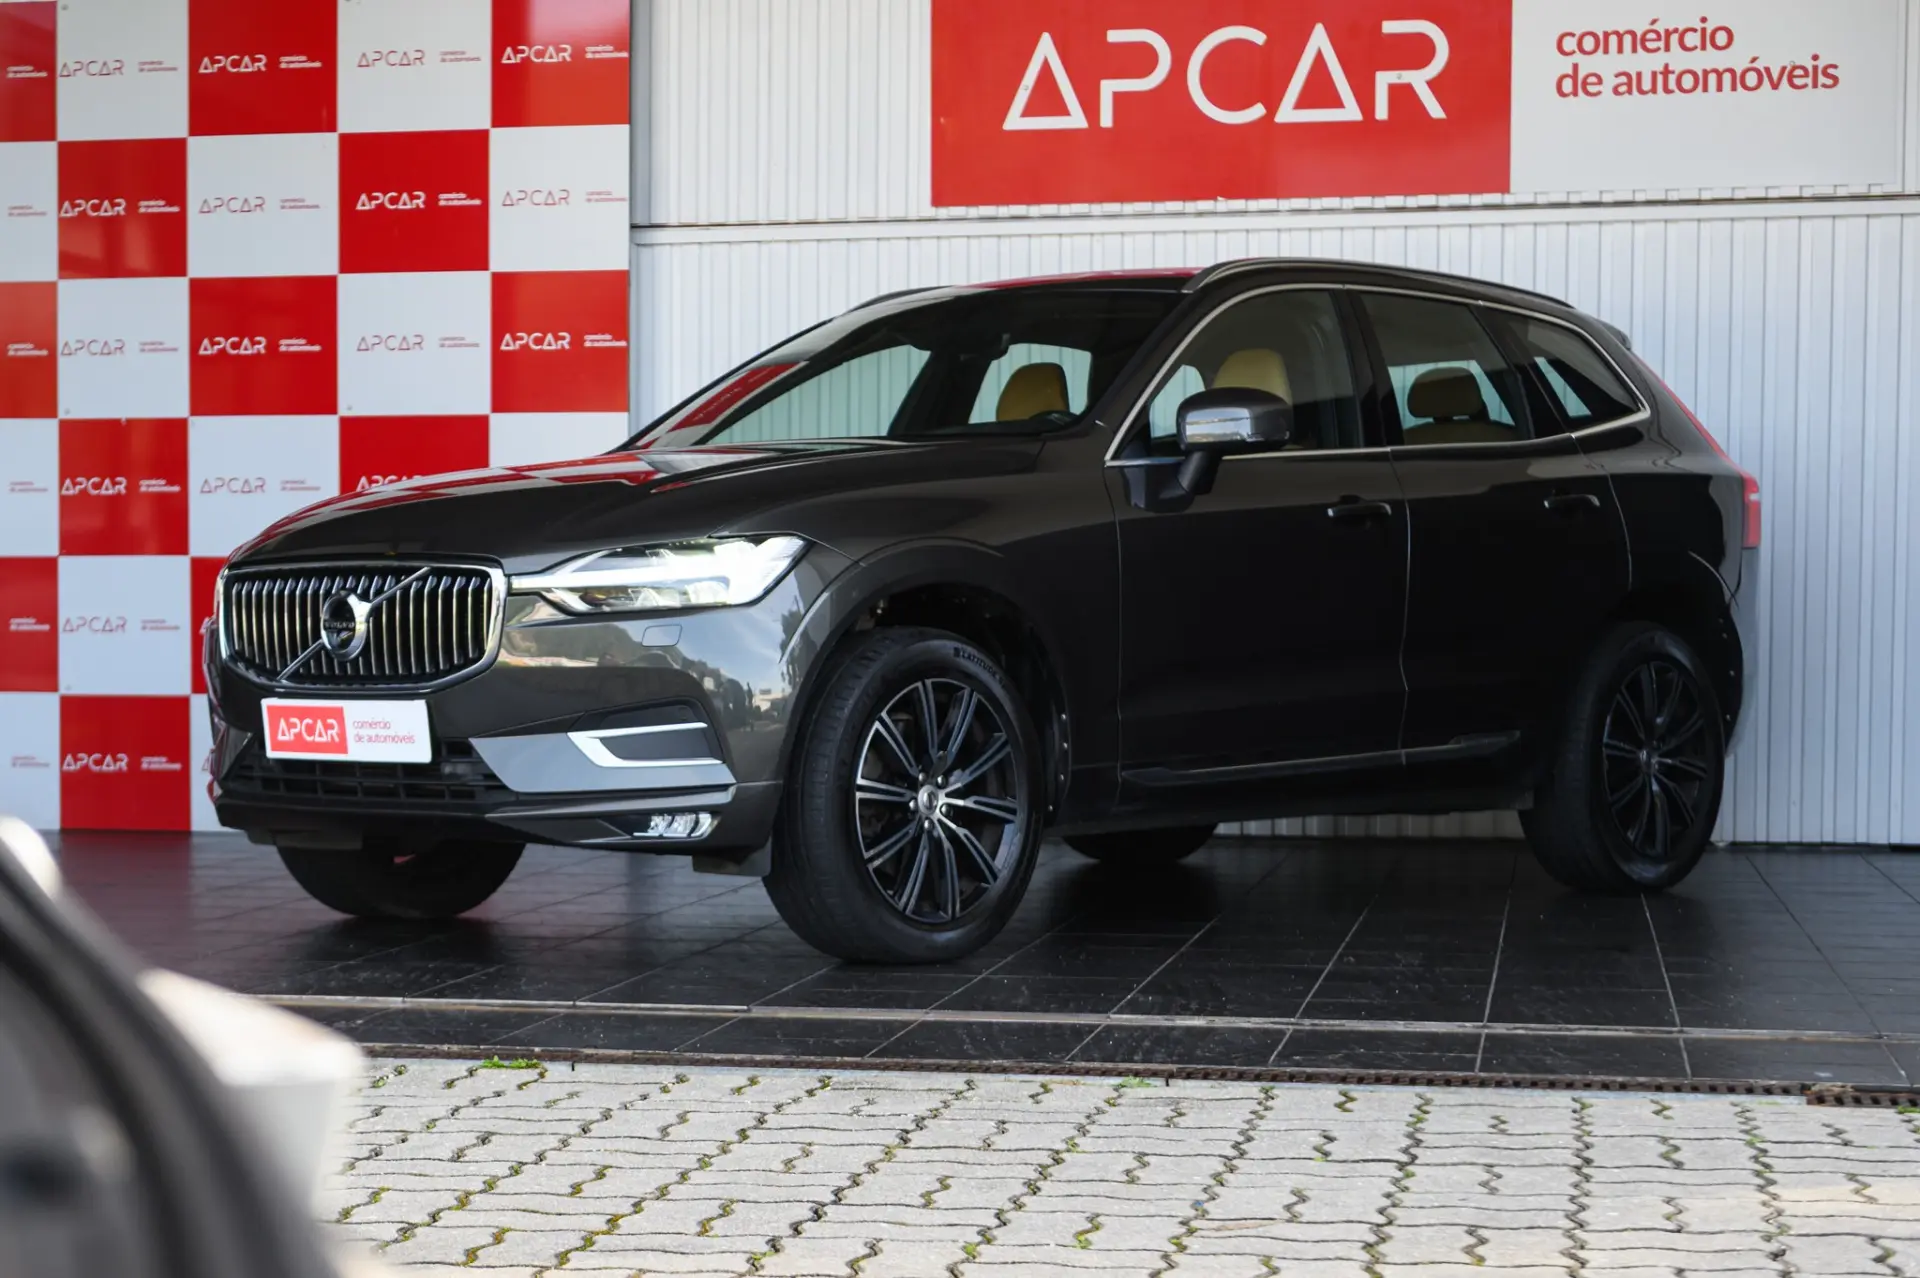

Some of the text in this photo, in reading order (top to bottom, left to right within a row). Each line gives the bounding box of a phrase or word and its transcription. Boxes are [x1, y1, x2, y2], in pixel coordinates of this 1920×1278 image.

[1555, 16, 1734, 56] comércio
[199, 54, 268, 74] APCAR
[356, 50, 426, 68] APCAR
[501, 44, 573, 65] APCAR
[59, 59, 124, 78] APCAR
[1003, 20, 1449, 130] APCAR
[1555, 54, 1840, 98] de automóveis
[59, 198, 126, 218] APCAR
[199, 196, 266, 215] APCAR
[356, 191, 426, 211] APCAR
[502, 189, 570, 208] APCAR
[59, 339, 125, 357] APCAR
[199, 336, 267, 356] APCAR
[356, 334, 424, 353] APCAR
[500, 332, 572, 351] APCAR
[61, 476, 127, 496] APCAR
[200, 477, 267, 495] APCAR
[62, 616, 127, 634] APCAR
[276, 717, 341, 743] APCAR
[352, 717, 391, 730] comércio
[354, 731, 416, 745] de automóveis
[62, 753, 128, 773] APCAR
